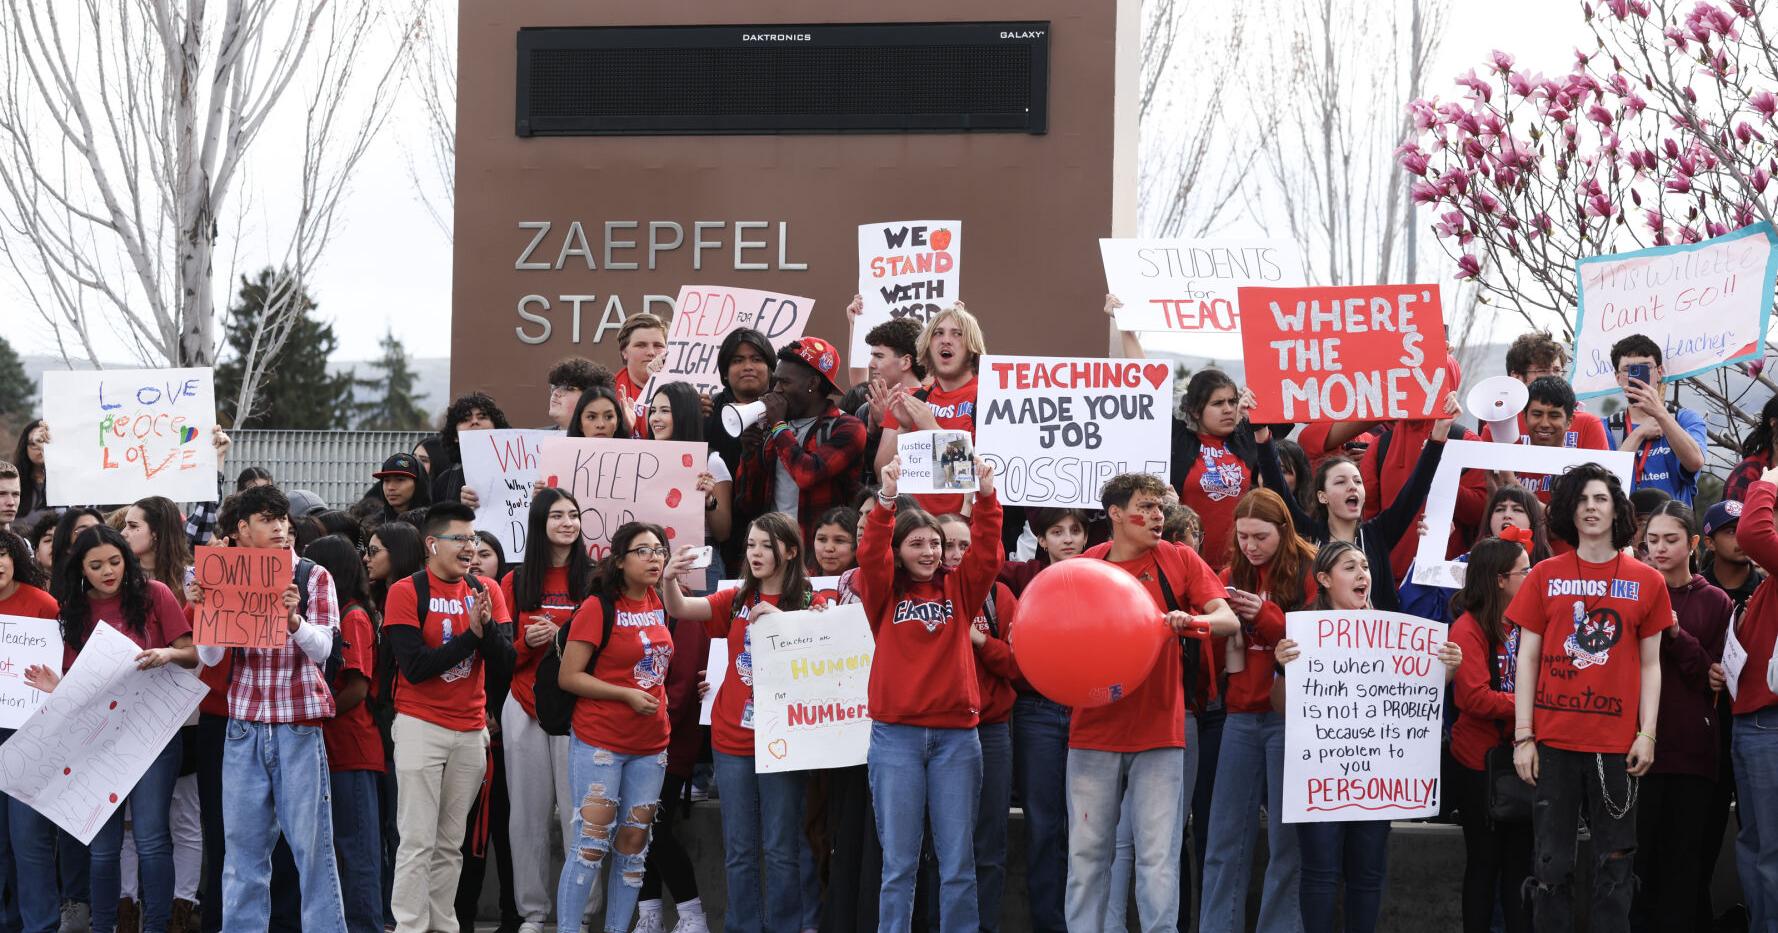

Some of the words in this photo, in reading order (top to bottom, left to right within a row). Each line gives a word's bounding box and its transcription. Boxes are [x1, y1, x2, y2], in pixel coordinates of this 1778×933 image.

[743, 33, 812, 42] DAKTRONICS
[515, 220, 808, 271] ZAEPFEL
[884, 226, 927, 250] WE
[870, 252, 953, 278] STAND
[1137, 247, 1282, 281] STUDENTS
[880, 279, 944, 304] WITH
[1184, 281, 1216, 299] for
[674, 291, 736, 338] RED
[736, 311, 753, 324] FOR
[754, 297, 799, 339] ED
[1601, 295, 1664, 332] Can't
[1270, 338, 1343, 372] THE
[1399, 332, 1425, 368] S
[992, 363, 1141, 389] TEACHING
[99, 379, 200, 410] LOVE
[1282, 367, 1446, 420] MONEY
[984, 397, 1073, 425] MADE
[1083, 394, 1154, 421] YOUR
[901, 442, 931, 450] Justice
[1039, 422, 1102, 449] JOB
[909, 455, 922, 464] for
[572, 449, 659, 502] KEEP
[902, 470, 930, 478] Pierce
[504, 479, 528, 498] Why
[202, 553, 247, 586] OWN
[260, 554, 282, 586] UP
[200, 587, 224, 608] TO
[238, 592, 280, 613] YOUR
[1611, 578, 1639, 601] IKE!
[0, 622, 47, 647] Teachers
[200, 610, 288, 646] MISTAKE
[1318, 618, 1439, 656] PRIVILEGE
[0, 657, 14, 675] ot
[1308, 657, 1324, 673] is
[1333, 657, 1384, 674] when
[1392, 655, 1431, 677] YOU
[1550, 667, 1577, 679] our
[0, 693, 25, 709] tion
[1302, 678, 1348, 697] think
[1356, 682, 1439, 702] something
[1536, 682, 1623, 713] ducators
[1303, 702, 1322, 718] is
[1327, 703, 1358, 719] not
[1365, 704, 1377, 718] a
[1383, 700, 1440, 721] PROBLEM
[1316, 724, 1376, 740] because
[1380, 723, 1400, 740] it's
[1407, 724, 1430, 740] not
[1302, 750, 1312, 761] a
[1319, 745, 1381, 764] problem
[1389, 744, 1404, 759] to
[1340, 760, 1371, 776] you
[1307, 777, 1438, 807] PERSONALLY!
